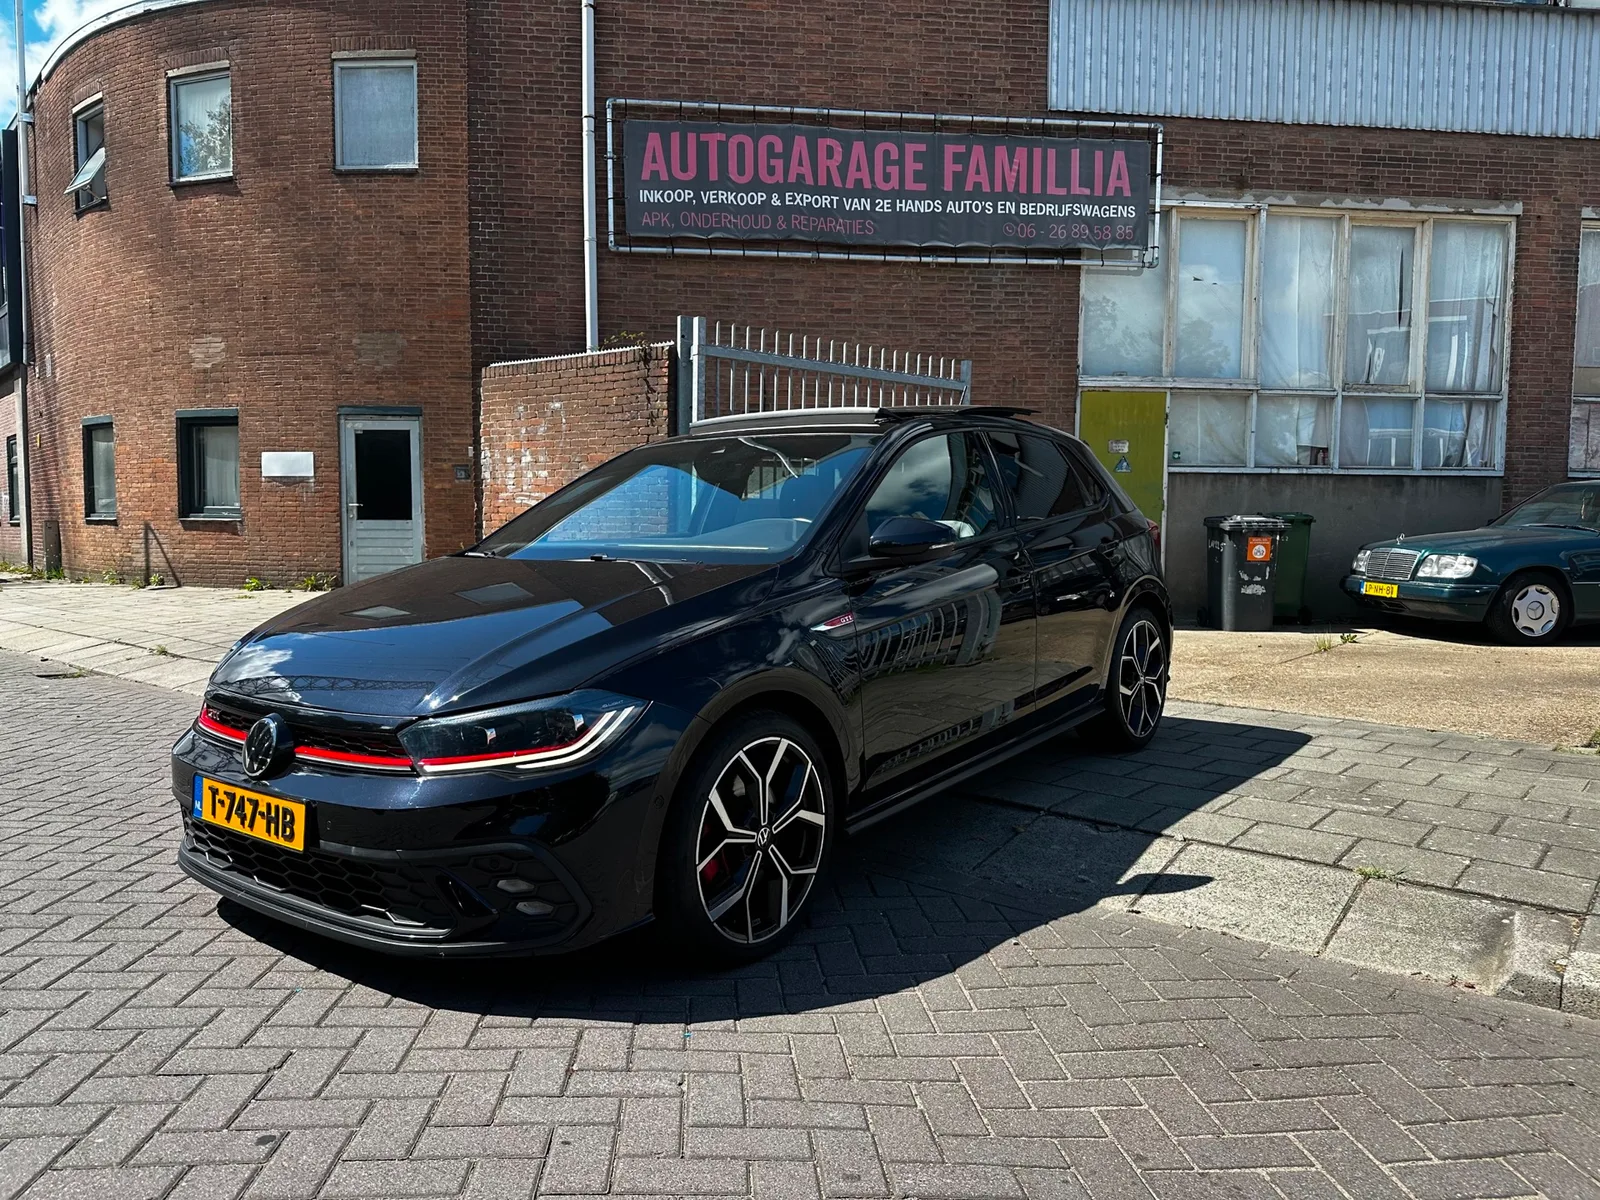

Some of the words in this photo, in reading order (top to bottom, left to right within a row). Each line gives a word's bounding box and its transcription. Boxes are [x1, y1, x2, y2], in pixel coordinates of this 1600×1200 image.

[641, 131, 927, 191] AUTOGARAGE
[943, 144, 1132, 197] FAMILLIA
[639, 189, 697, 205] INKOOP,
[700, 190, 767, 206] VERKOOP
[771, 193, 782, 206] &
[785, 192, 840, 209] EXPORT
[843, 198, 871, 212] VAN
[875, 199, 892, 212] 2E
[896, 199, 943, 213] HANDS
[946, 200, 993, 214] AUTO'S
[997, 201, 1016, 215] EN
[1019, 202, 1136, 218] BEDRIJFSWAGENS
[641, 211, 675, 229] APK,
[680, 211, 772, 230] ONDERHOUD
[776, 215, 787, 230] &
[791, 217, 875, 235] REPARATIES
[1017, 222, 1036, 238] 06
[1049, 223, 1067, 239] 26
[1071, 223, 1089, 239] 89
[1094, 225, 1112, 240] 58
[1115, 225, 1134, 240] 85
[840, 615, 853, 623] GTI
[194, 799, 203, 811] NL
[208, 785, 296, 843] T-747-HB
